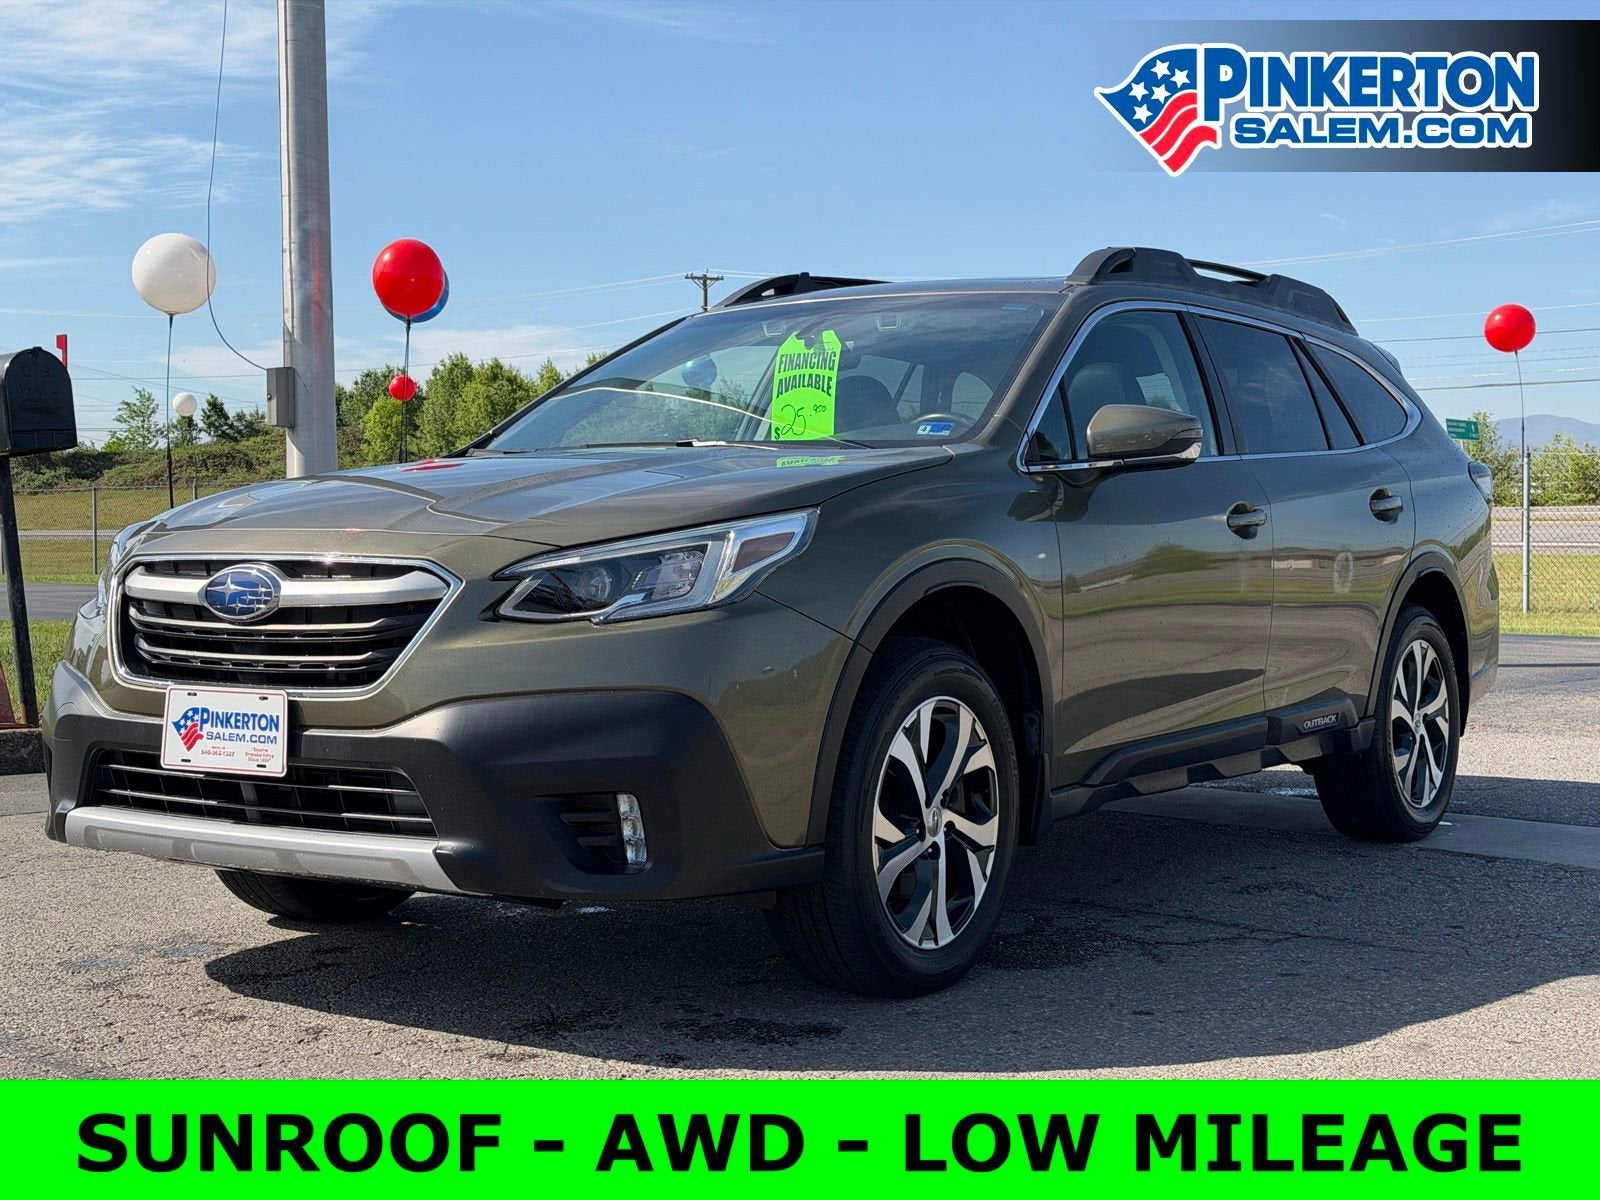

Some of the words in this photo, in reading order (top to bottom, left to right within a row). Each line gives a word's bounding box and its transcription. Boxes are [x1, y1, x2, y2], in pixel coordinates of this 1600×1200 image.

[777, 350, 837, 374] FINANCING
[776, 373, 833, 399] AVAILABLE
[199, 706, 280, 733] PINKERTON
[1303, 713, 1338, 729] OUTBACK
[206, 730, 278, 745] SALEM.COM
